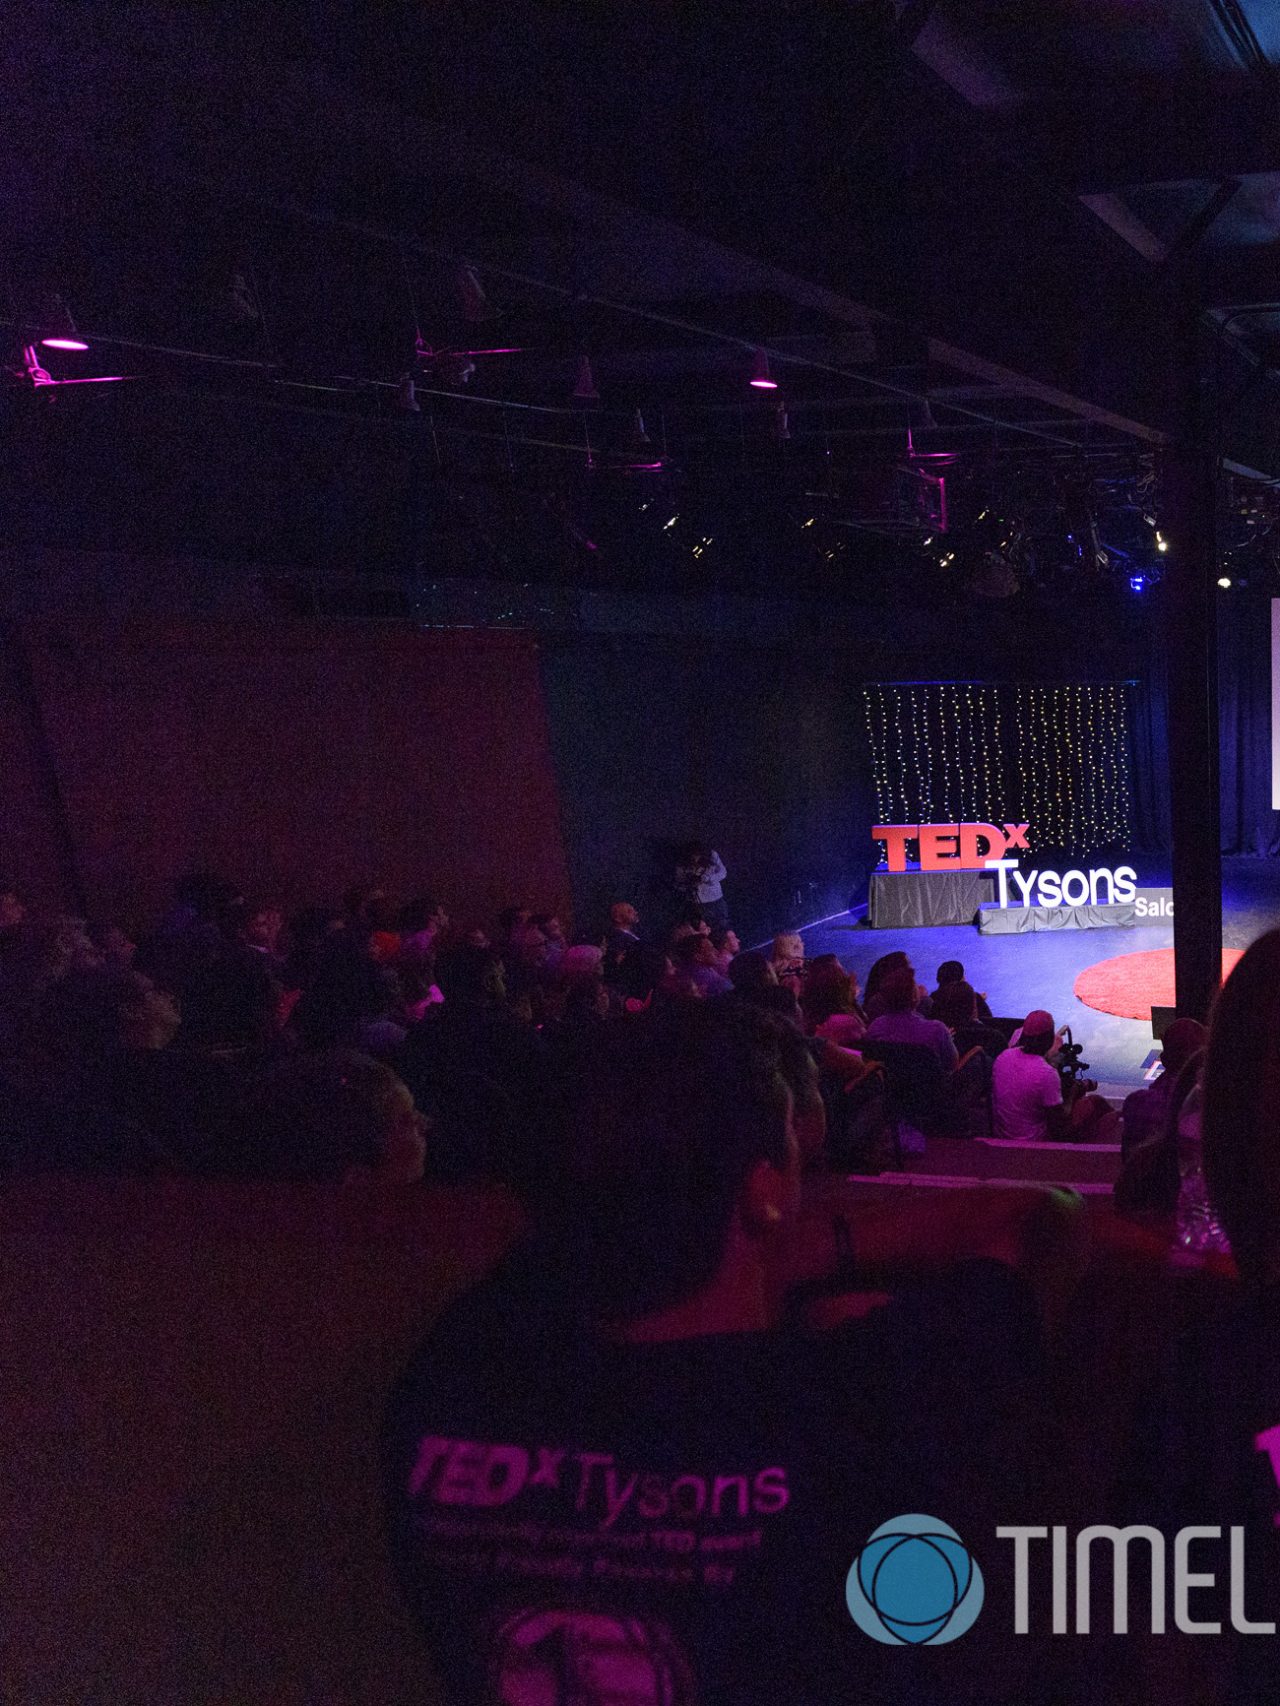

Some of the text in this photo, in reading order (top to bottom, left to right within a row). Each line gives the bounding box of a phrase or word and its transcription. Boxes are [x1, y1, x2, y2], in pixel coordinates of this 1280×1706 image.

[871, 823, 1030, 872] TEDx
[985, 859, 1137, 909] Tysons
[1134, 897, 1175, 918] Salo
